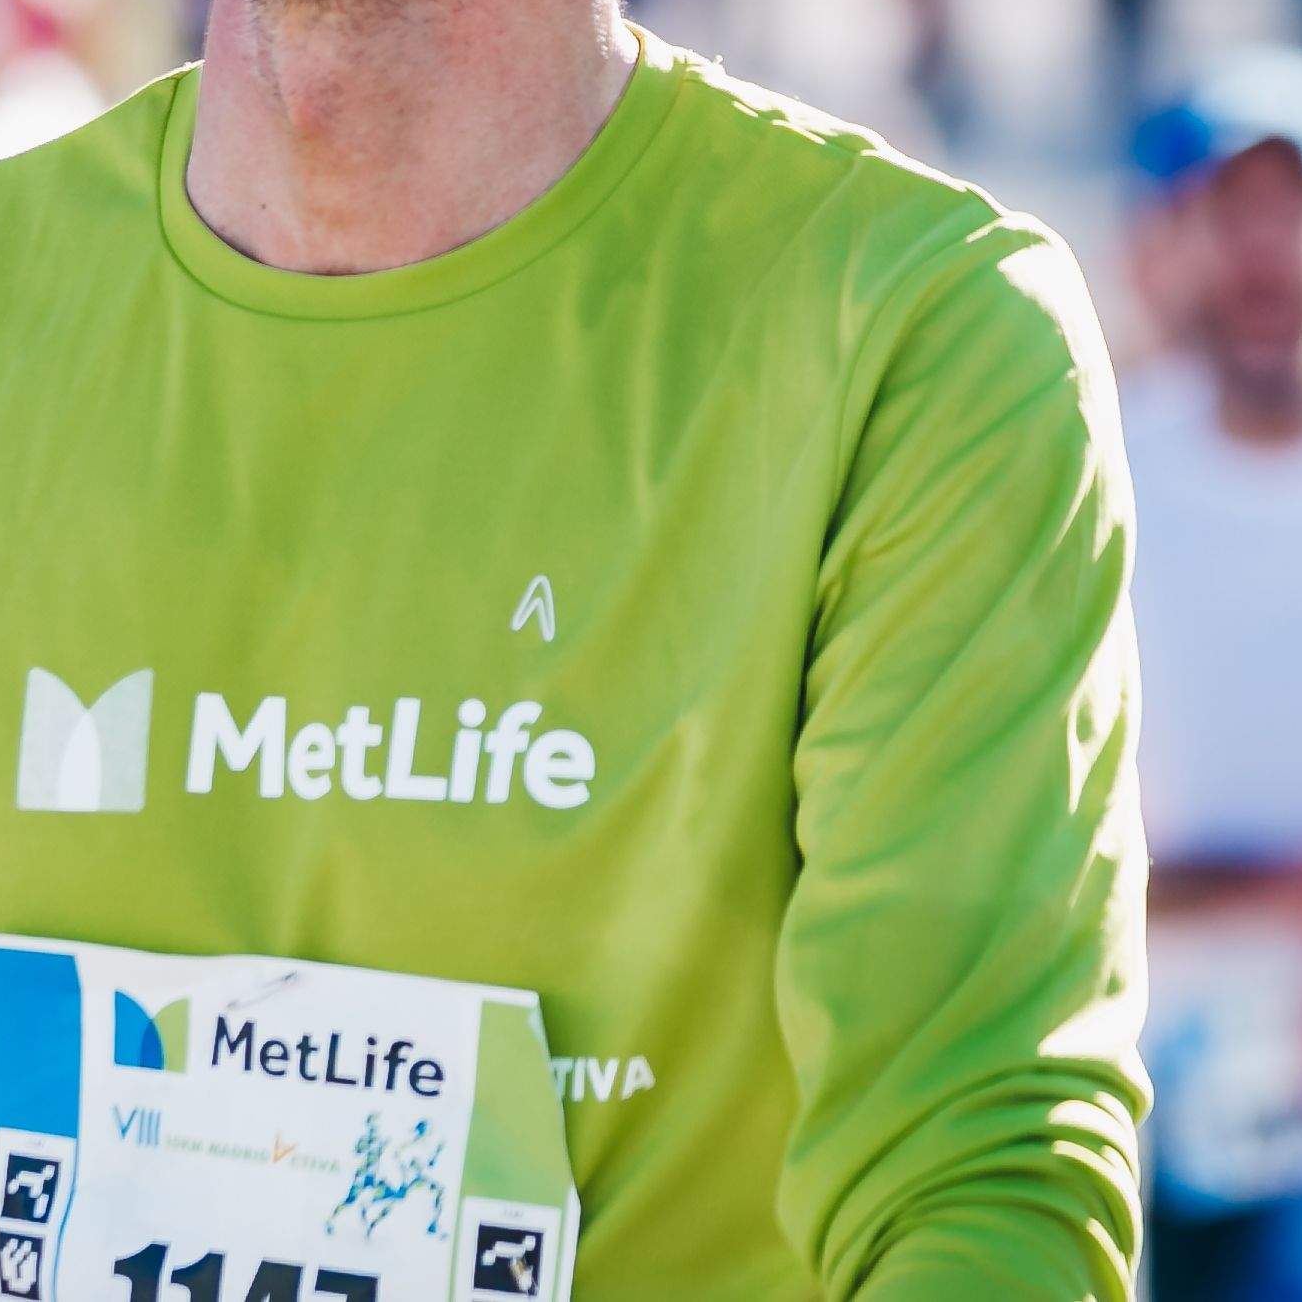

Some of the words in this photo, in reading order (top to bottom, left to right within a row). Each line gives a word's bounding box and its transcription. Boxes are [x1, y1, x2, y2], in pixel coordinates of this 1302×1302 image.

[186, 691, 596, 809] MetLife
[210, 1015, 445, 1098] MetLife
[113, 1104, 162, 1148] VIII
